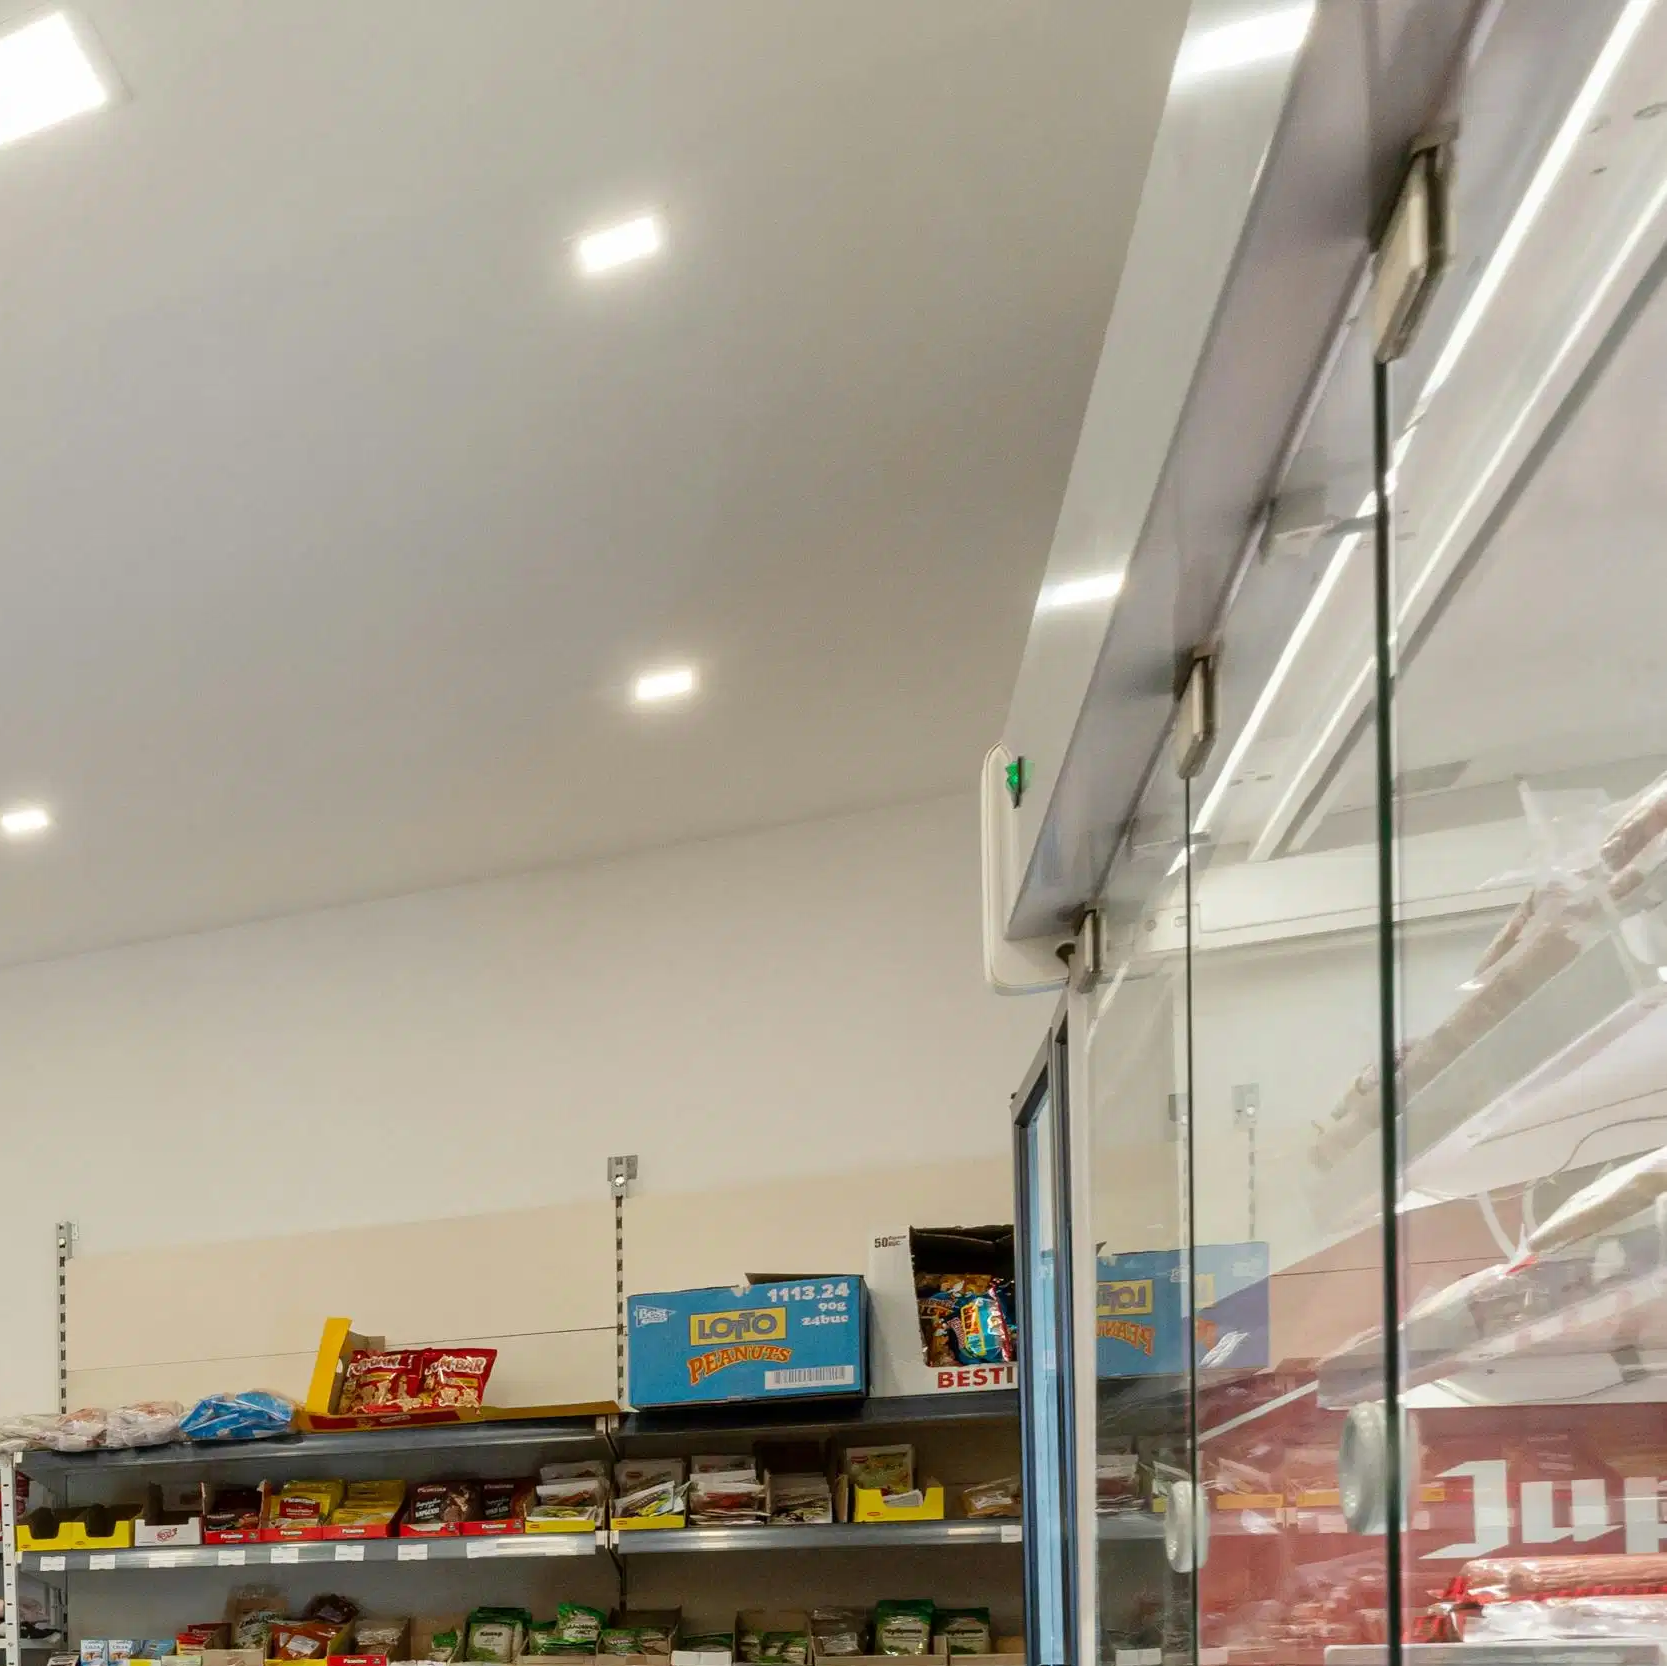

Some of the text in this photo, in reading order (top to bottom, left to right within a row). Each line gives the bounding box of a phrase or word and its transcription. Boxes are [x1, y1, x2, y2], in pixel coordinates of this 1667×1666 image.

[874, 1237, 888, 1248] 50
[768, 1283, 850, 1303] 1113.24
[818, 1301, 847, 1314] 90g
[698, 1311, 777, 1339] LOTTO
[801, 1312, 849, 1327] 24buc
[687, 1346, 793, 1385] PEANUTS
